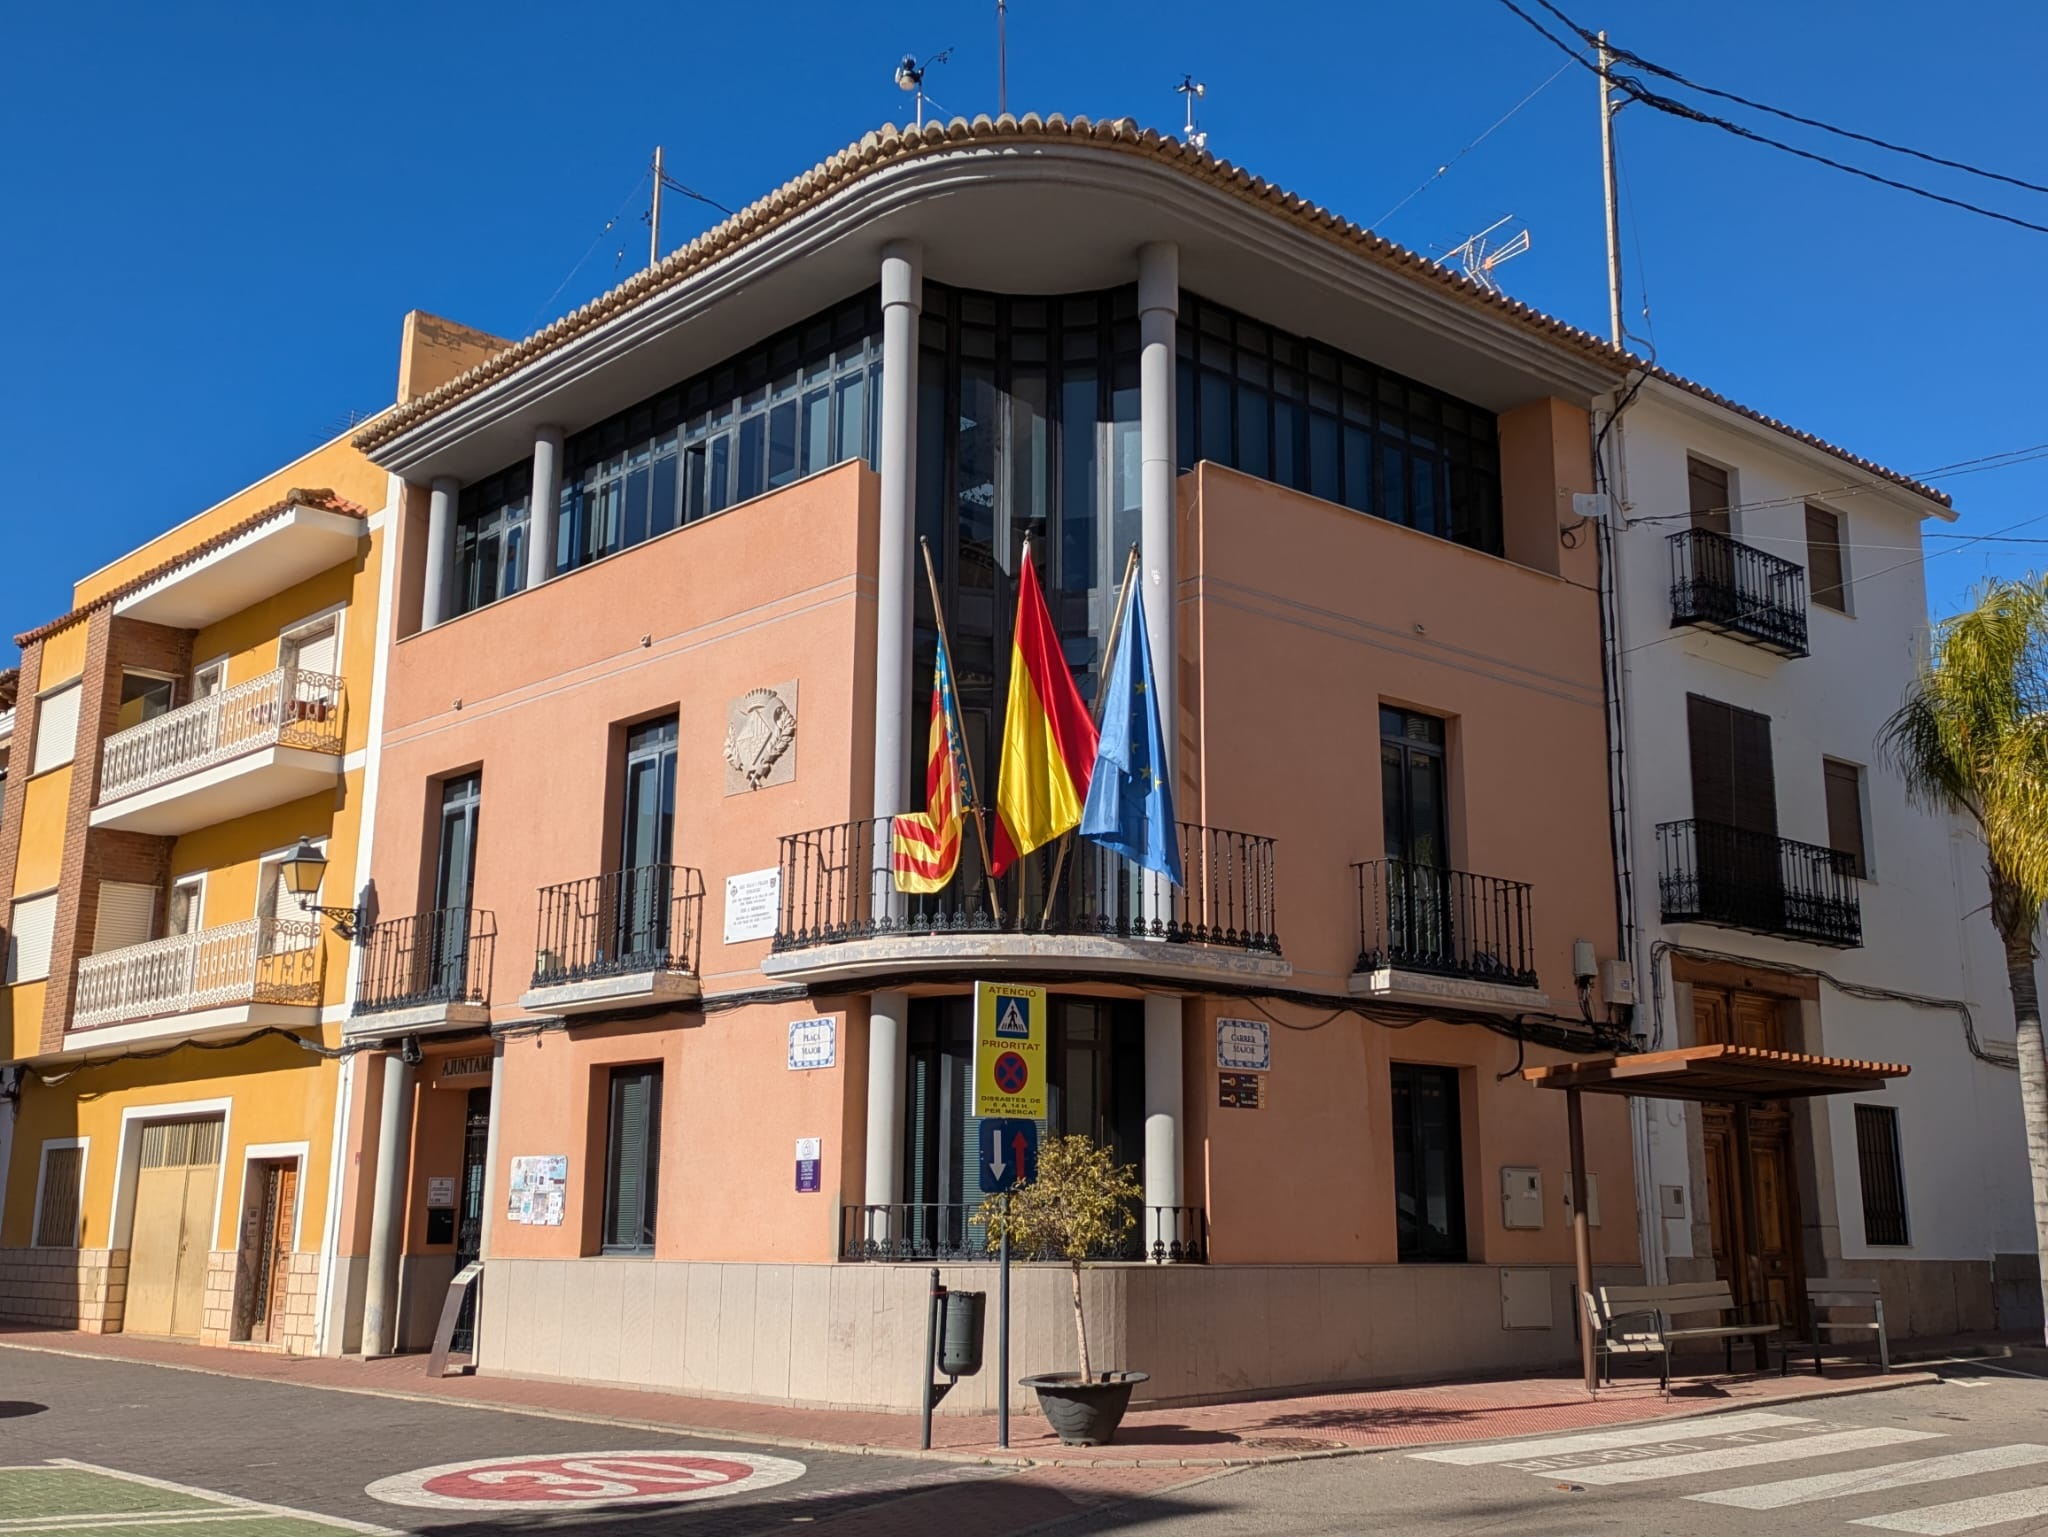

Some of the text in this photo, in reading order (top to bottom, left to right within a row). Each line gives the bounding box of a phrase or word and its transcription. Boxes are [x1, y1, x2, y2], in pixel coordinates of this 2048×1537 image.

[988, 986, 1037, 998] ATENCIÓ
[1231, 1033, 1256, 1044] CARRER
[801, 1045, 821, 1055] MAJOR
[982, 1039, 1041, 1051] PRIORITAT
[1232, 1045, 1256, 1055] MAJOR
[468, 1460, 730, 1497] 30
